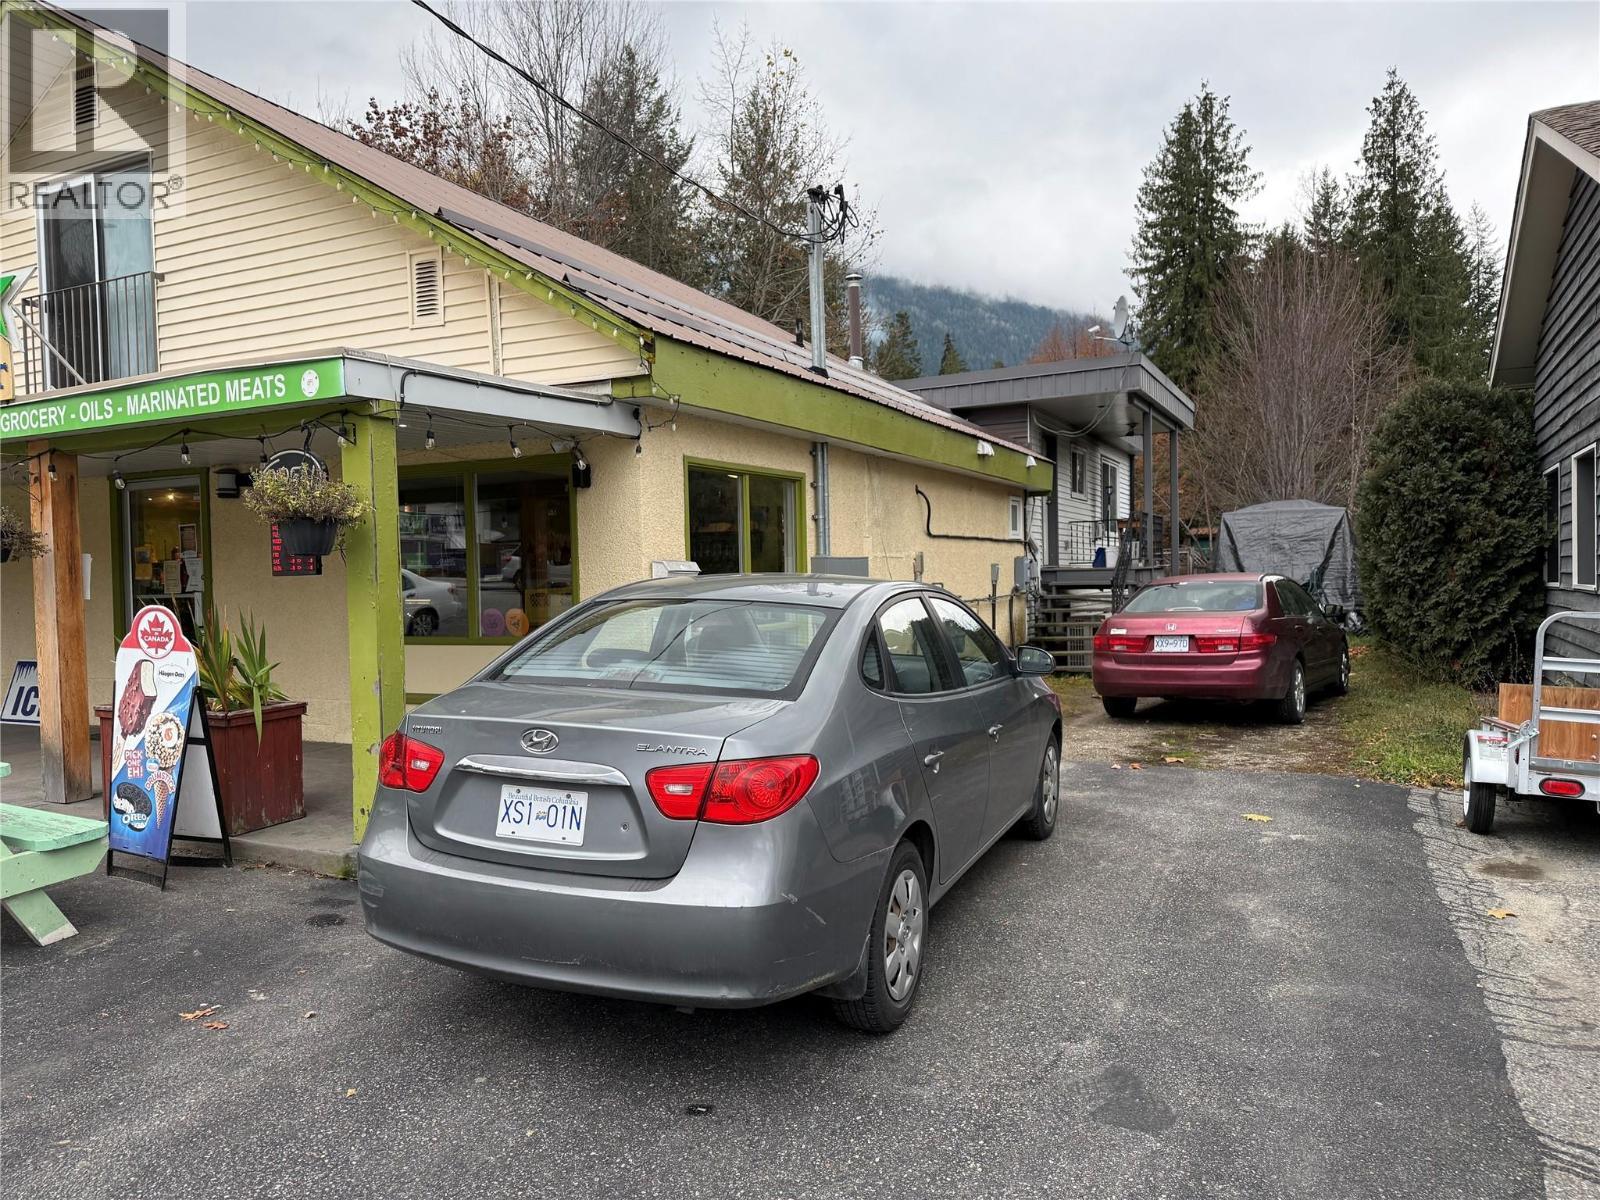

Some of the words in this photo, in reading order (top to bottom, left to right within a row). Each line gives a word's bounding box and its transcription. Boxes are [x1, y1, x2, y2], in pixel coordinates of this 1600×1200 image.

[0, 404, 67, 433] GROCERY
[79, 398, 114, 423] OILS
[126, 382, 220, 416] MARINATED
[225, 373, 286, 402] MEATS
[144, 635, 170, 643] CANADA
[11, 686, 40, 717] IC
[125, 750, 143, 760] PICK
[636, 743, 709, 757] ELANTRA
[128, 767, 144, 779] EH!
[145, 770, 176, 794] DRUMSTICK
[122, 813, 147, 824] OREO
